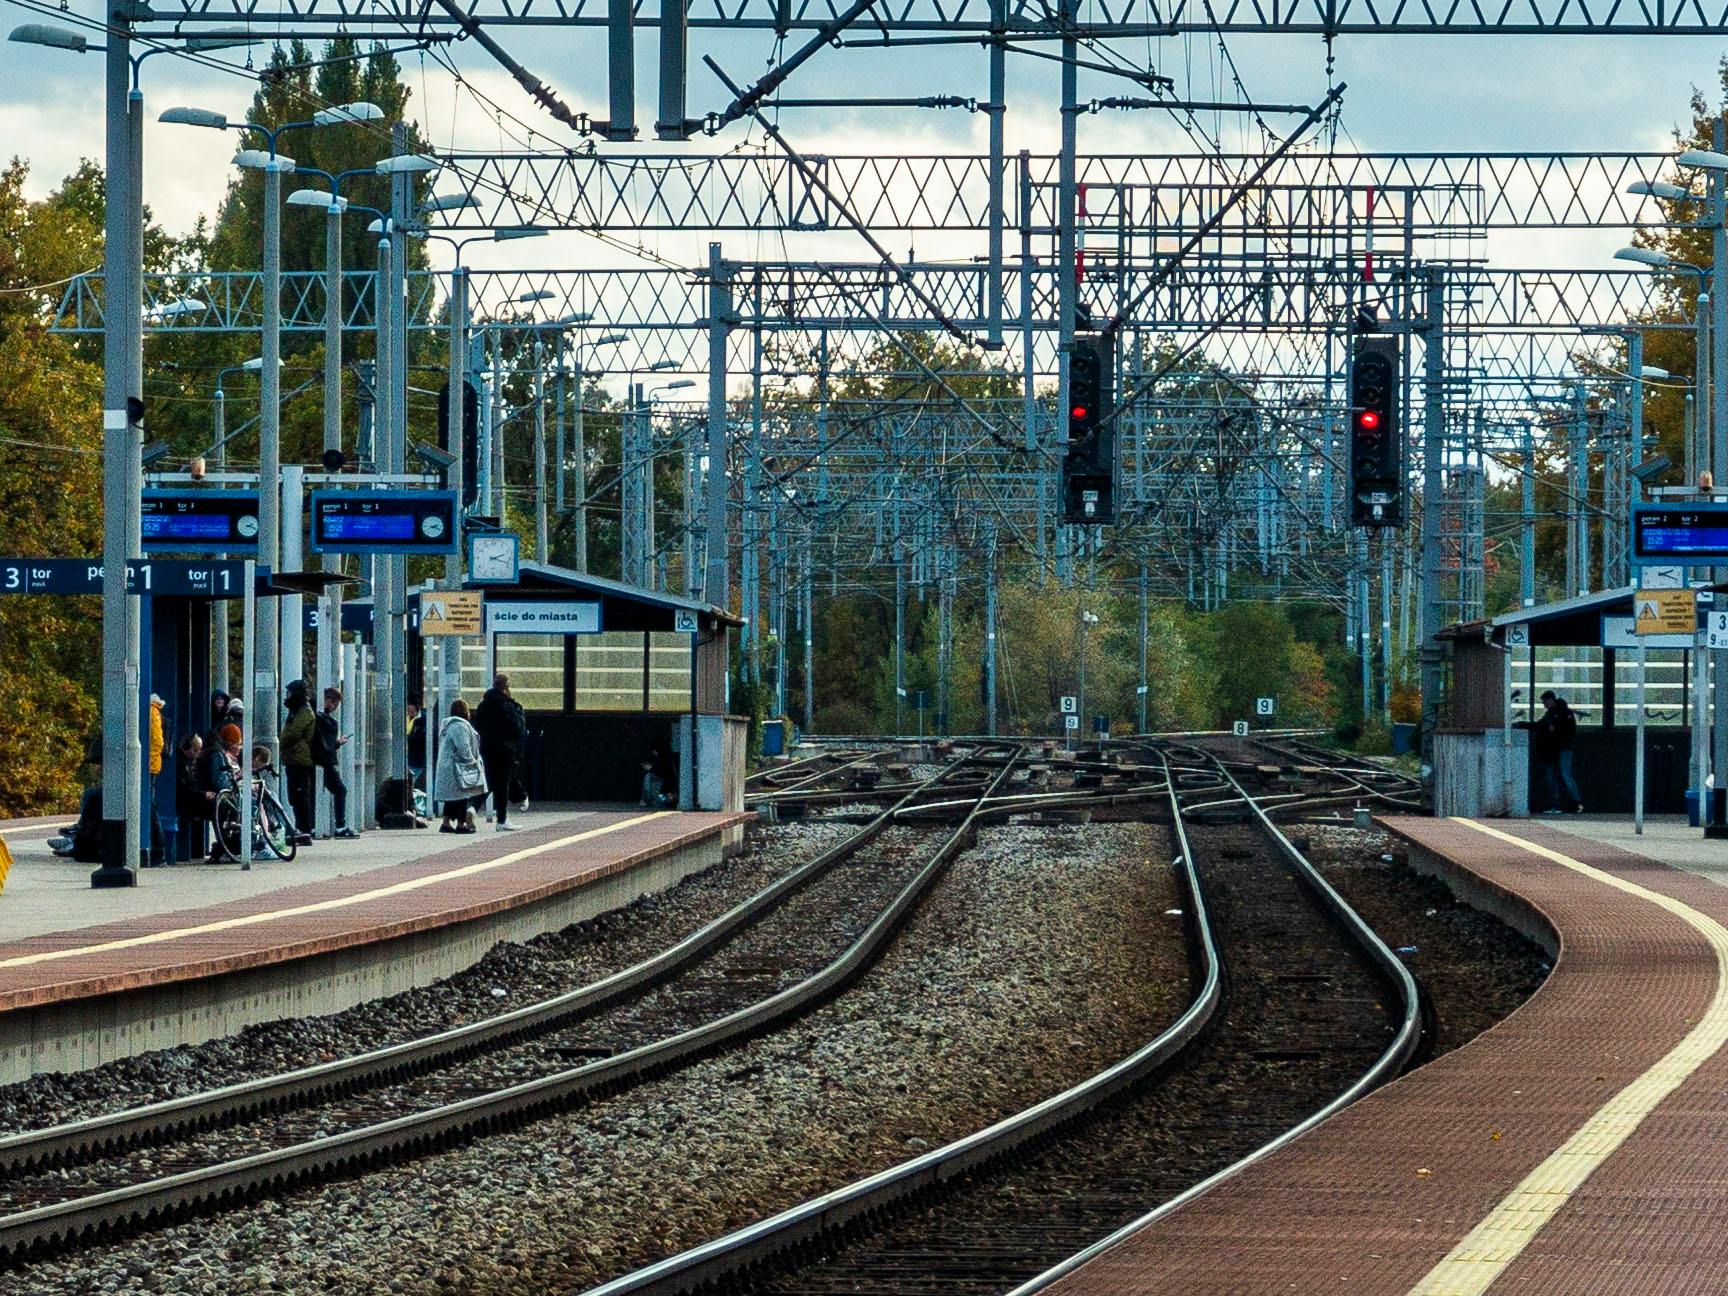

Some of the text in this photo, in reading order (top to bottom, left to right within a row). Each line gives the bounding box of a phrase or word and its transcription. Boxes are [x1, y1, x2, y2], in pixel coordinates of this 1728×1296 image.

[5, 567, 51, 588] 3 tor
[140, 565, 151, 589] 1
[188, 569, 230, 590] tor 1
[522, 611, 535, 621] do
[539, 611, 578, 621] miasta
[1719, 615, 1726, 630] 3
[1710, 634, 1716, 645] 9
[1065, 698, 1072, 710] 9
[1260, 700, 1268, 712] 9
[1237, 723, 1244, 734] 8
